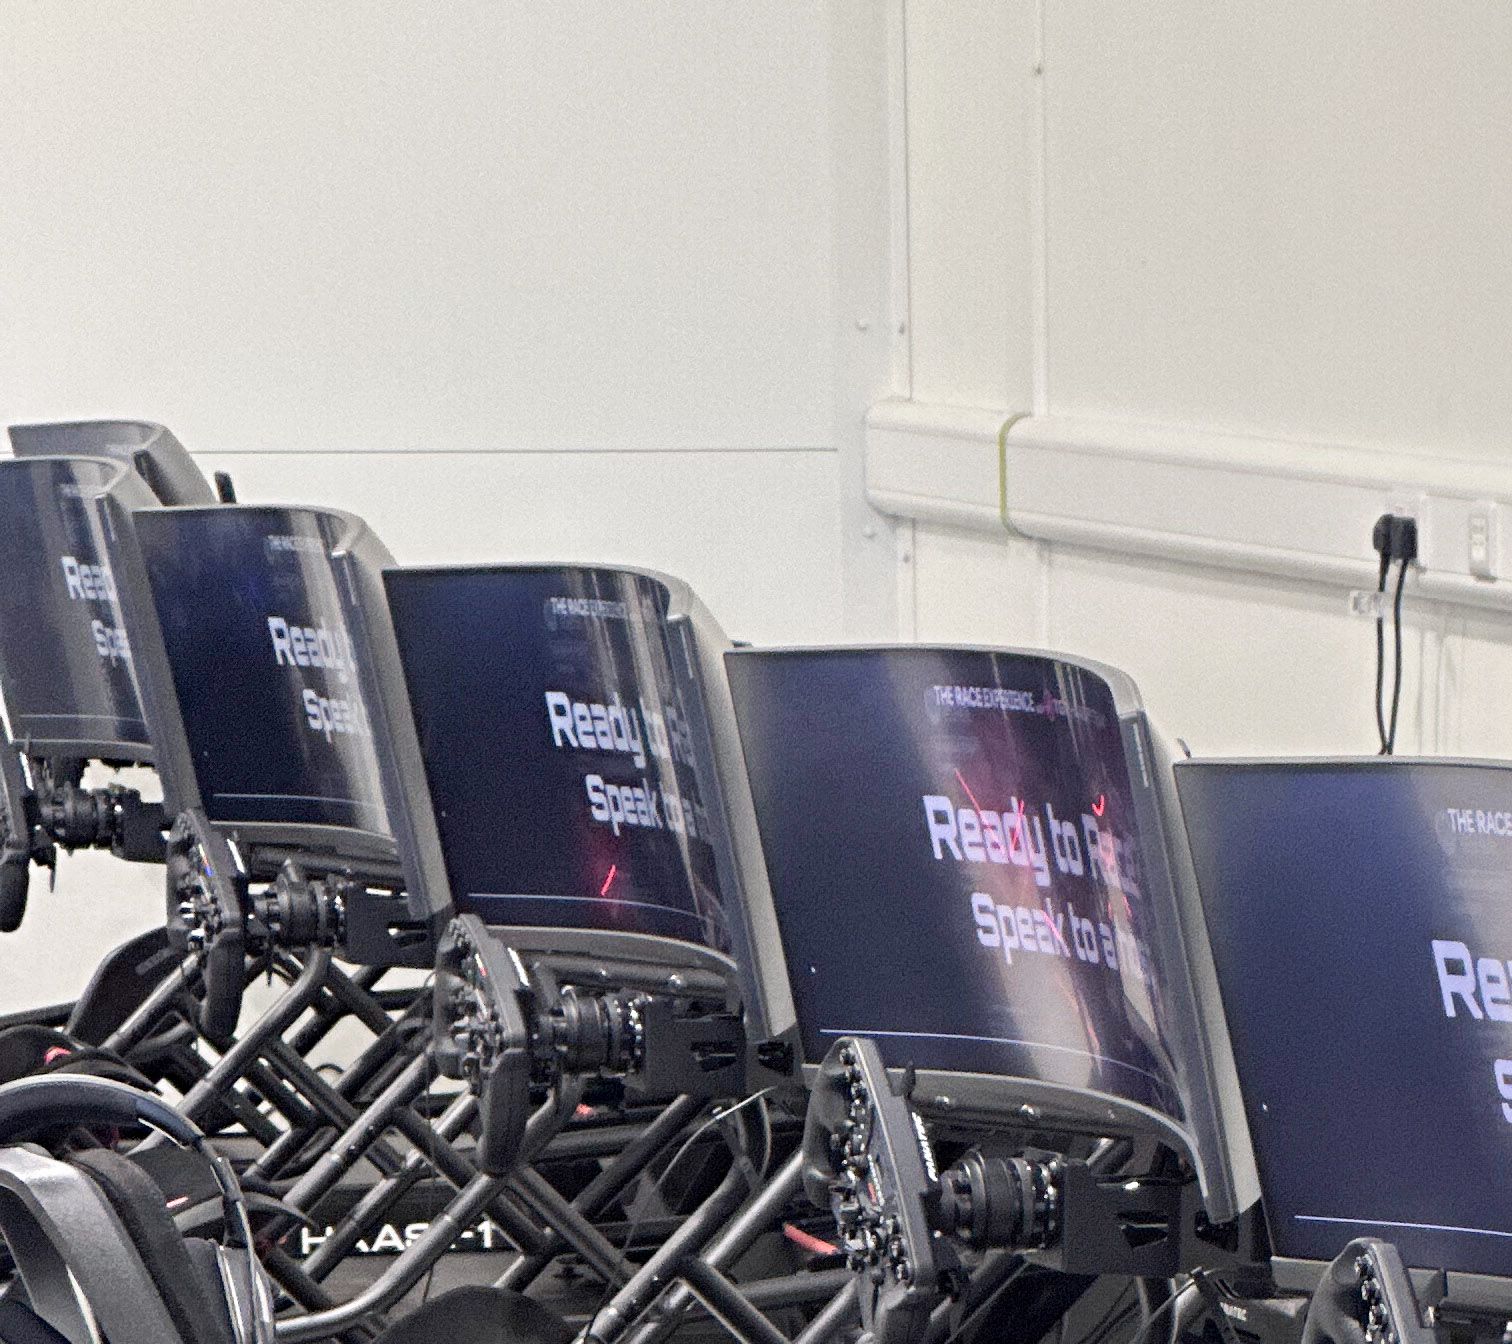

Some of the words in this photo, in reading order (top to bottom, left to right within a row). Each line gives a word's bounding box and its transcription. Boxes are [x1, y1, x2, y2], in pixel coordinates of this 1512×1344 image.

[544, 691, 647, 769] Ready
[585, 774, 664, 836] Speak
[923, 795, 1050, 887] Ready
[1045, 803, 1085, 877] to
[1447, 808, 1476, 833] THE
[971, 892, 1072, 965] Speak
[1067, 902, 1099, 965] to
